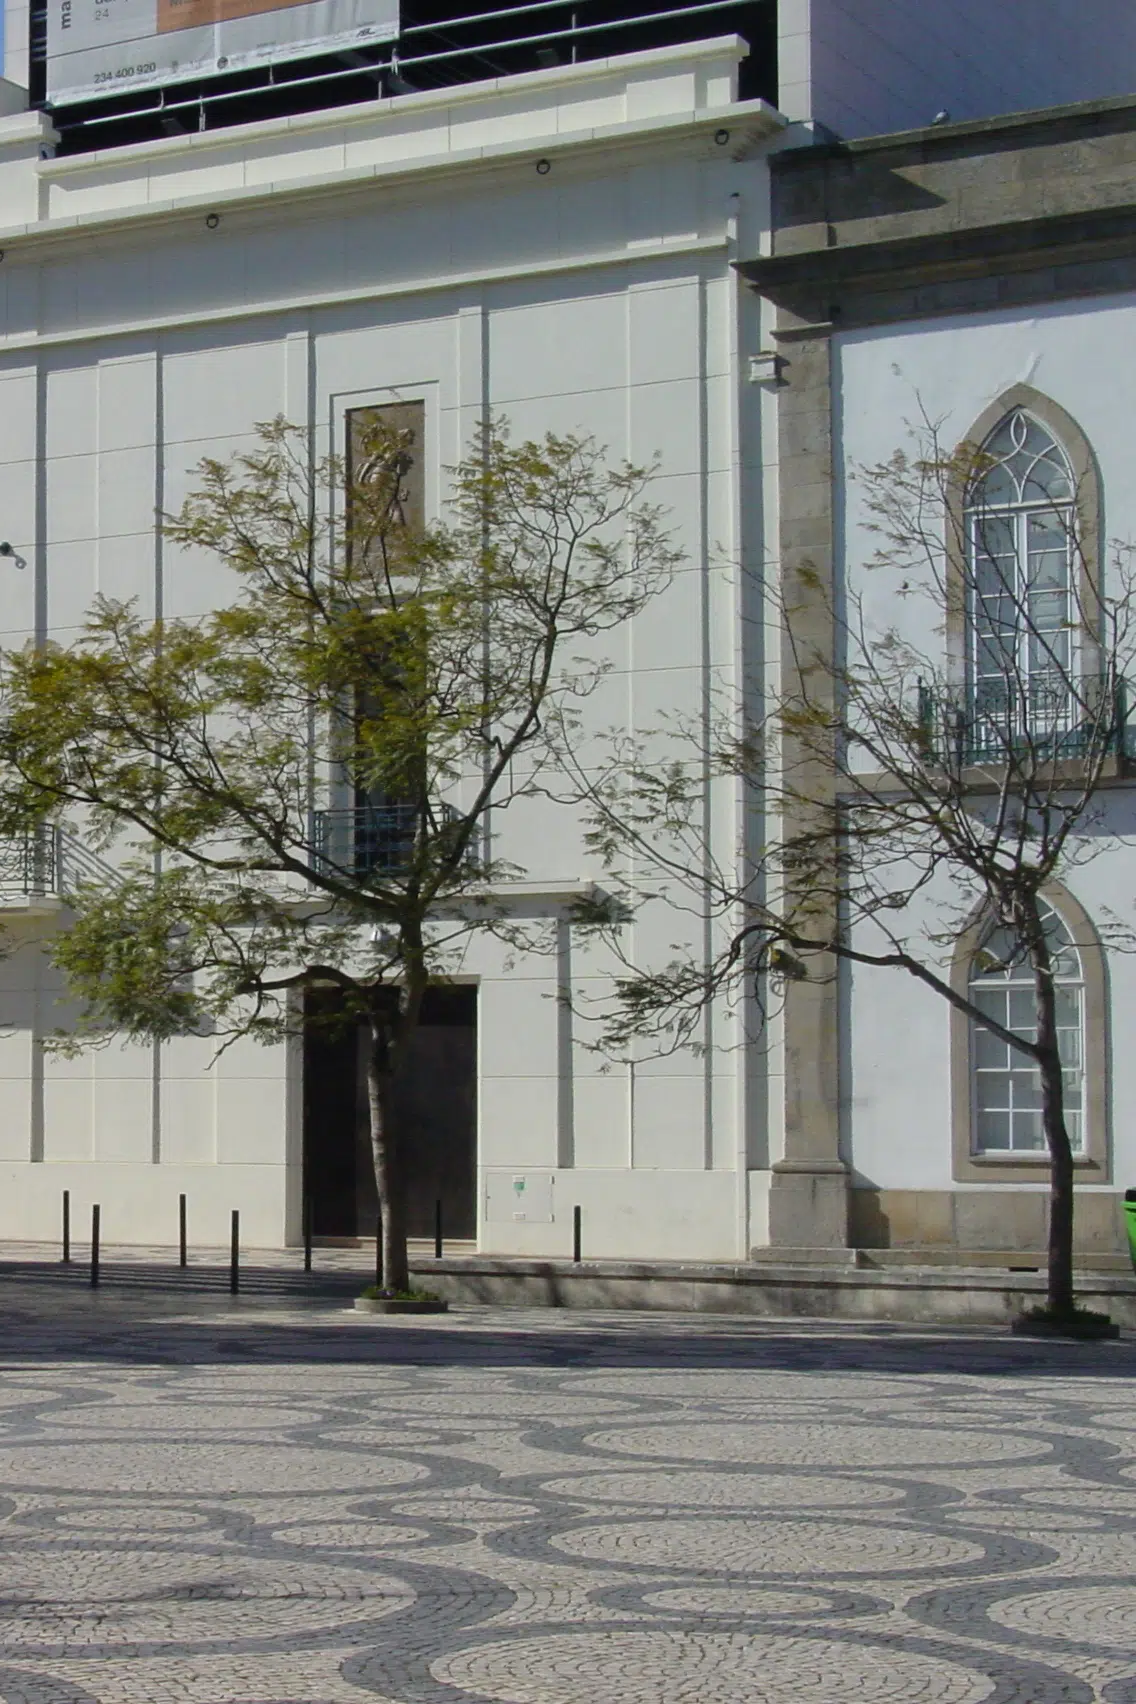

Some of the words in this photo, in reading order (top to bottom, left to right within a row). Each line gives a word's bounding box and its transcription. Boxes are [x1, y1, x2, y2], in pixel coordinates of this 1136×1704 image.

[93, 71, 113, 84] 234
[115, 66, 135, 79] 400
[136, 62, 156, 74] 920
